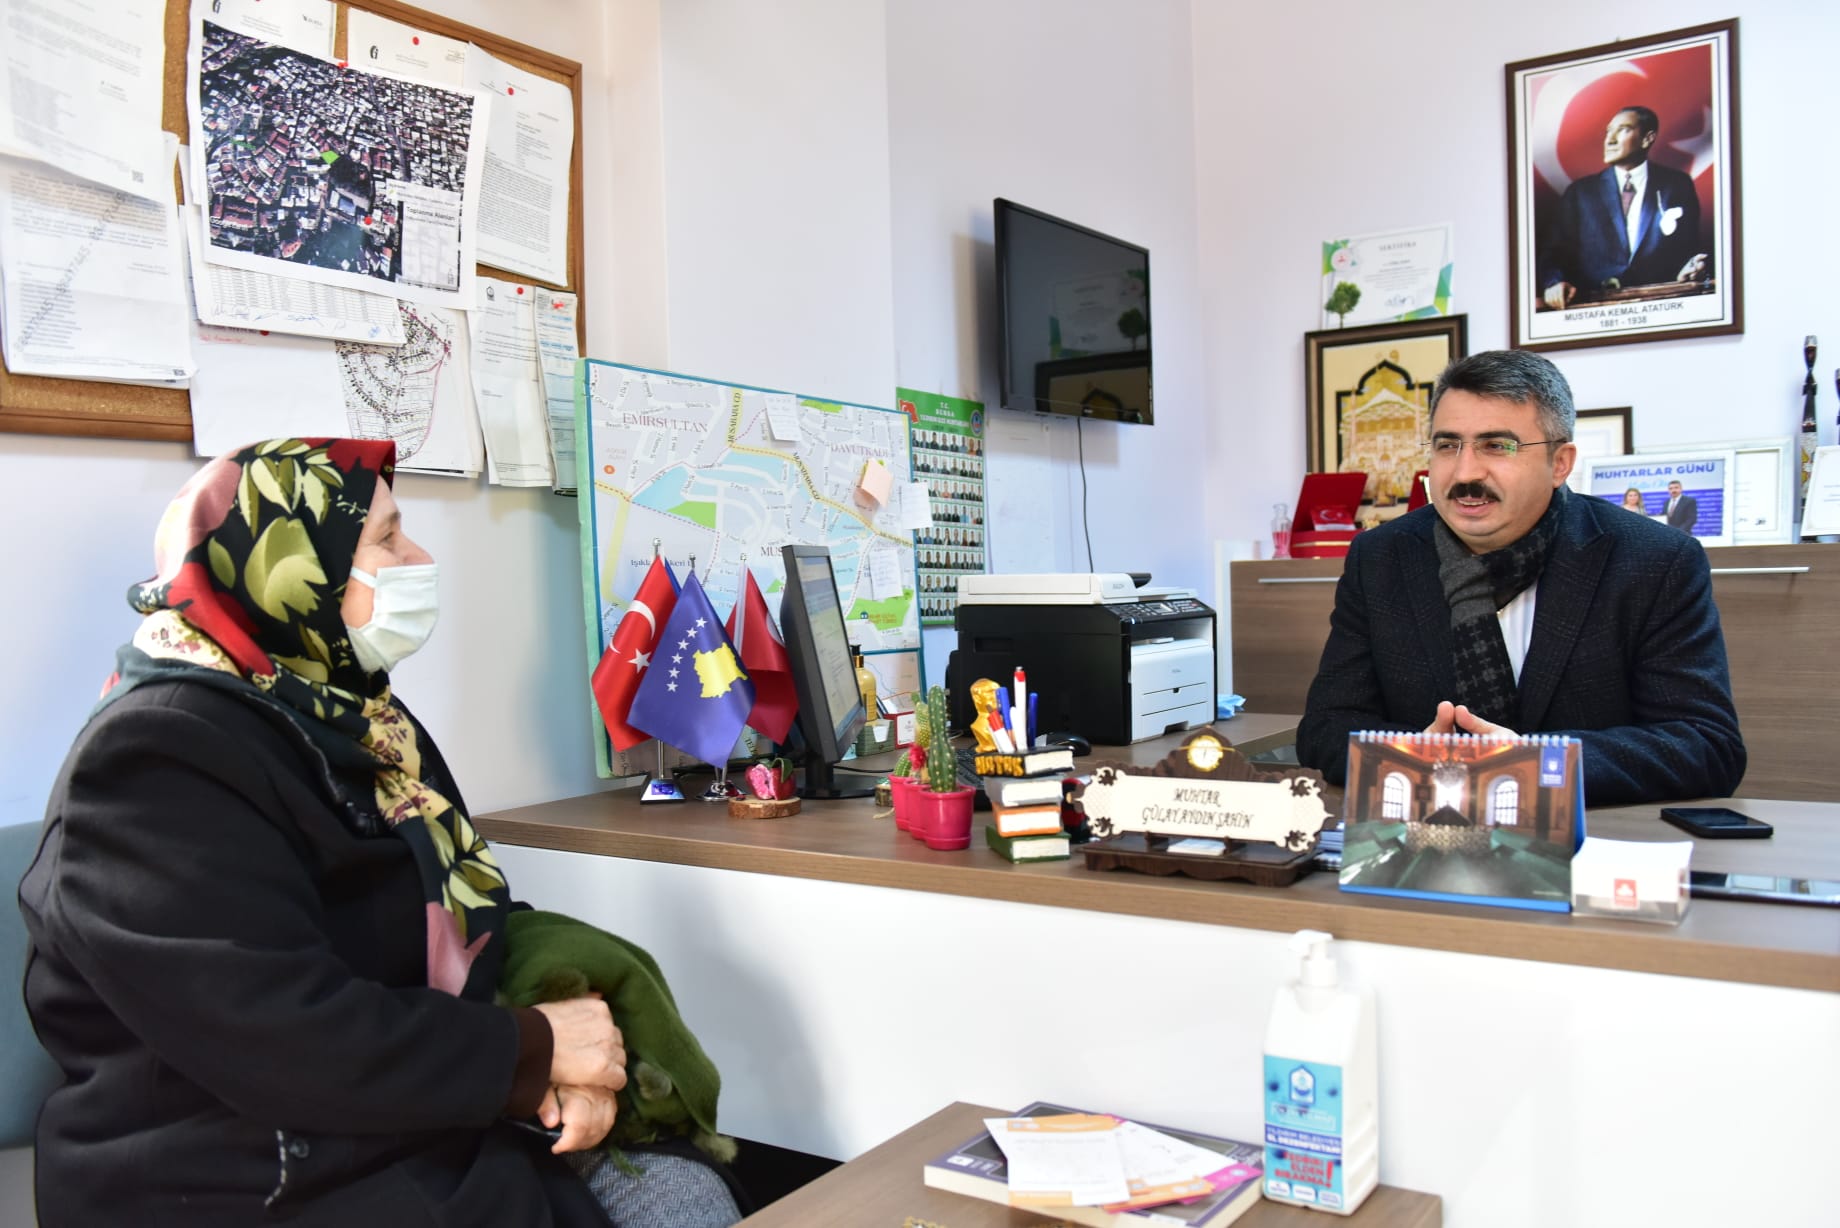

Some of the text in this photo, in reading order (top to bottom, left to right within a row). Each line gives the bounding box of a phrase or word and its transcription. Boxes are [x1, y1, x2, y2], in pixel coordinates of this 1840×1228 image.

[1564, 301, 1684, 321] MUSTAFA KEMAL ATATÜRK
[1599, 318, 1619, 328] 1881
[1627, 316, 1648, 326] 1938
[1594, 461, 1716, 480] MUHTARLAR GÜNÜ
[1174, 788, 1221, 807] MUHTAR
